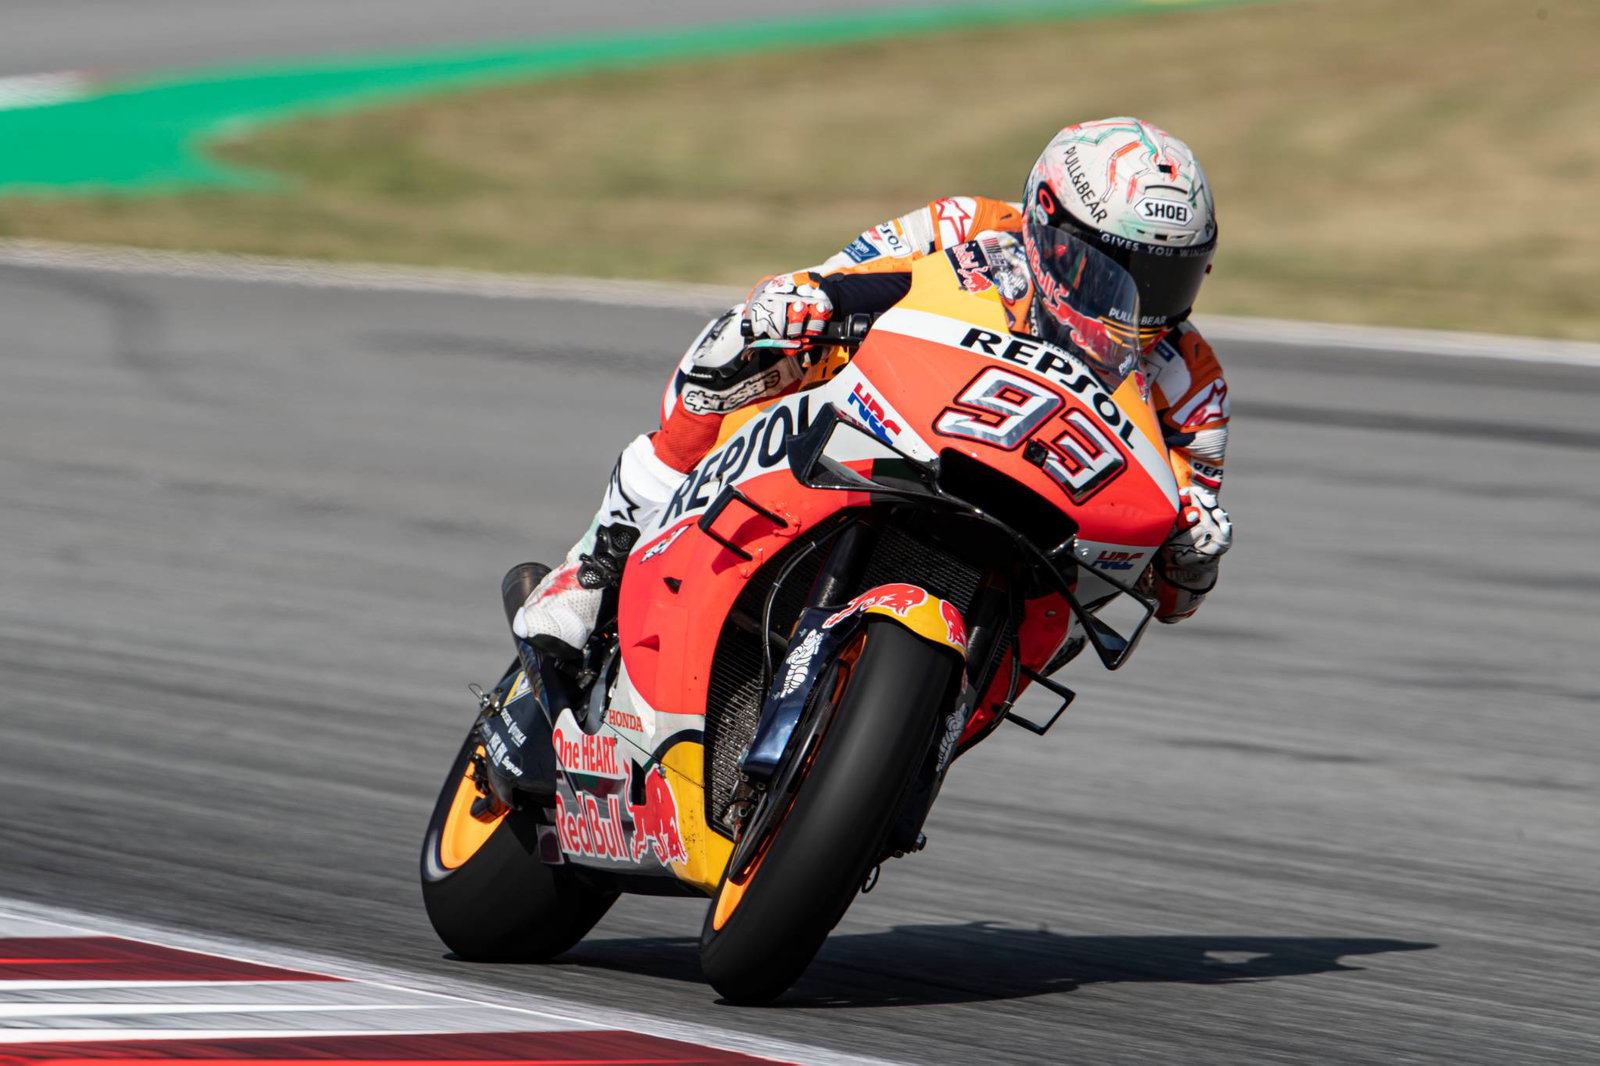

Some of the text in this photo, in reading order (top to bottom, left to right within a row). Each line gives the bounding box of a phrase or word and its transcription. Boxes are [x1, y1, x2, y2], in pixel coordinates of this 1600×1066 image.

[1063, 145, 1109, 225] PULL&BEAR
[1144, 202, 1188, 222] SHOEI
[1100, 233, 1140, 252] GIVES
[1147, 244, 1174, 257] YOU
[960, 328, 1135, 450] REPSOL
[932, 365, 1128, 506] 93
[1193, 462, 1223, 481] REP
[608, 709, 643, 733] HONDA
[553, 728, 580, 769] One
[556, 792, 630, 862] Red Bull
